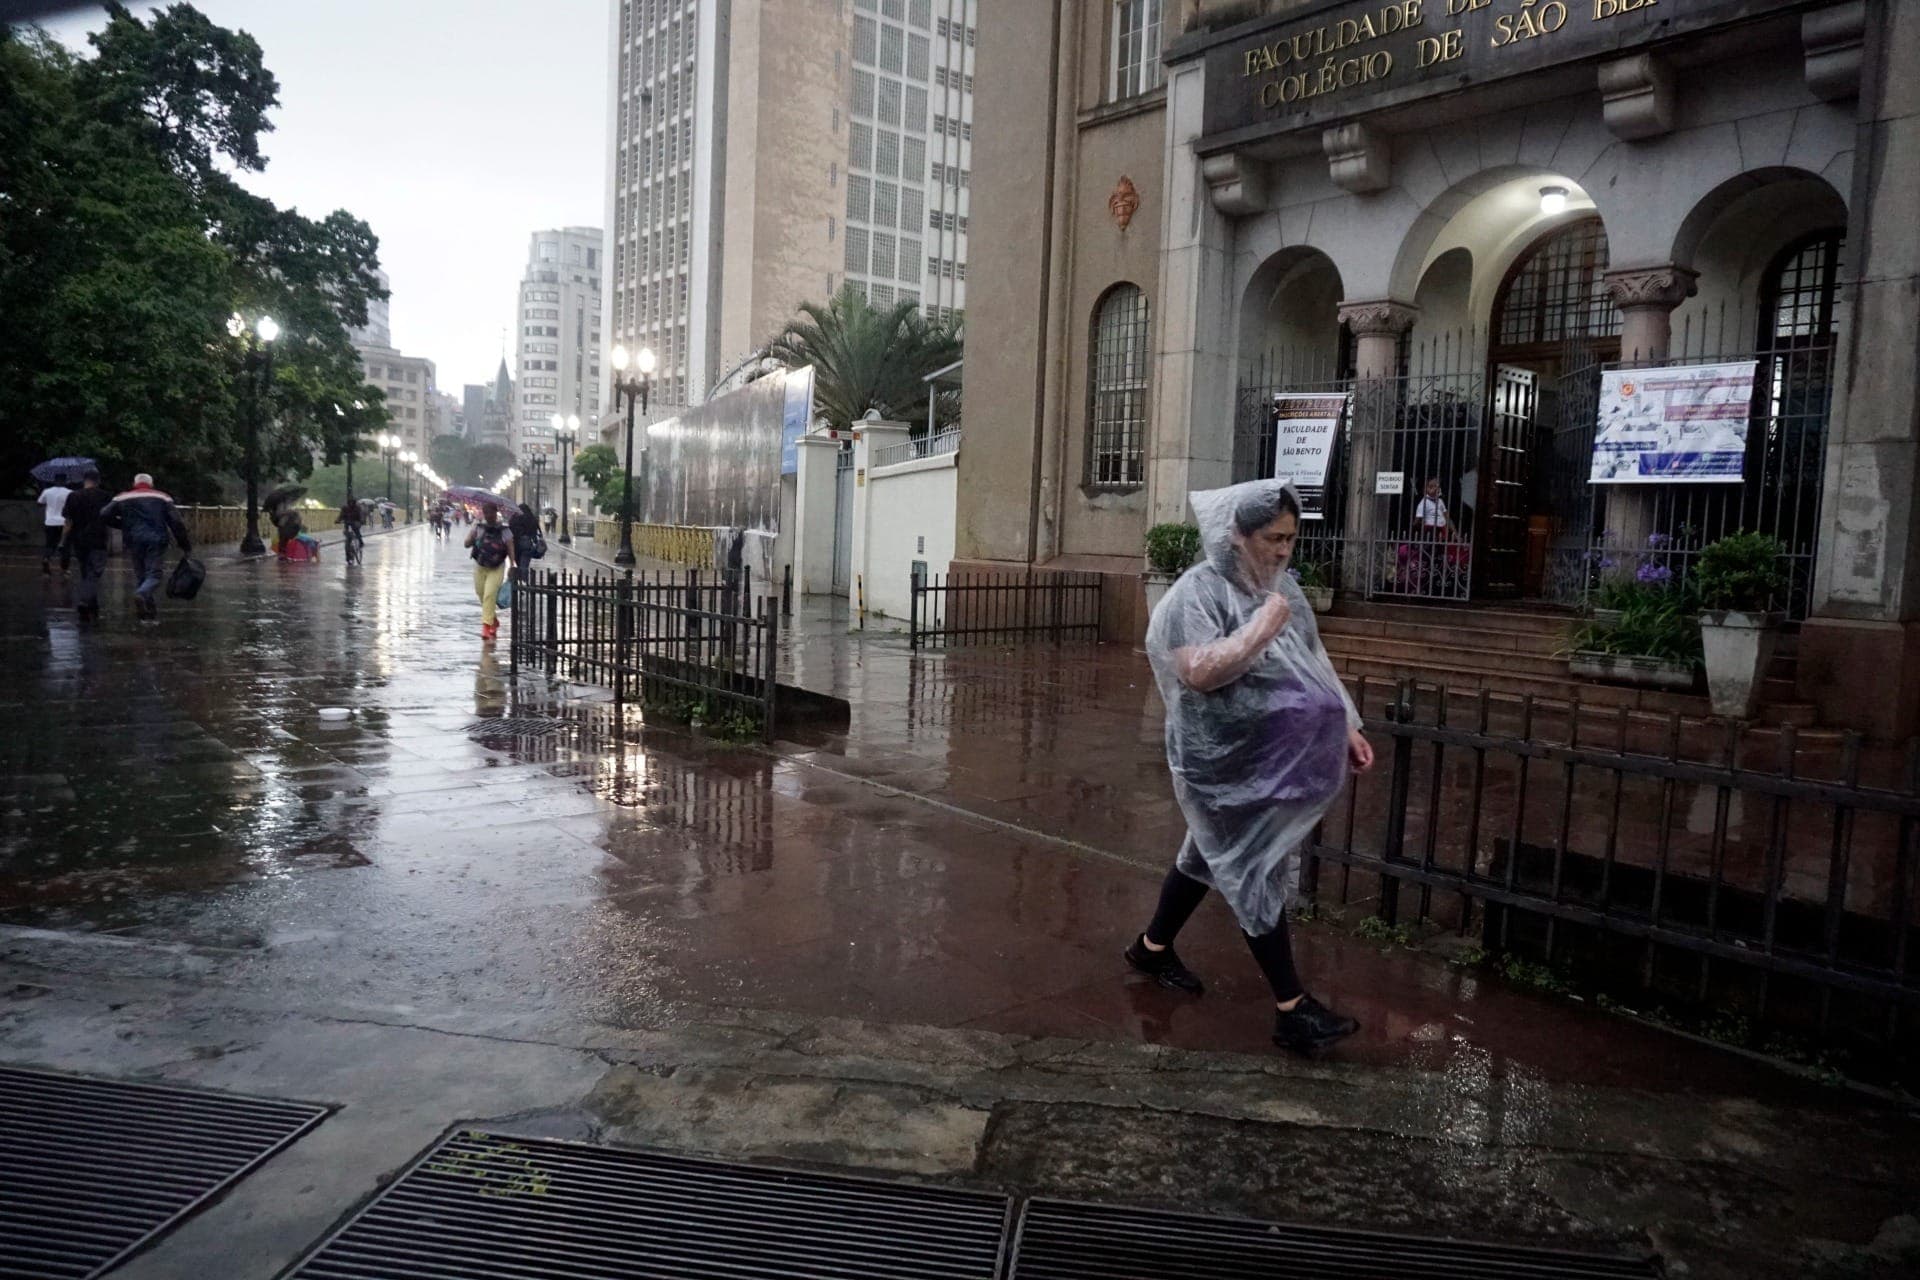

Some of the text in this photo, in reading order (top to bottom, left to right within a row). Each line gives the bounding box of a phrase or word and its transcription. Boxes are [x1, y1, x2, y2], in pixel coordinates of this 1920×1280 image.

[1243, 0, 1423, 77] FACULDADE
[1261, 50, 1393, 109] COLÉGIO
[1416, 29, 1465, 69] DE
[1491, 0, 1568, 47] SÃO
[1283, 425, 1328, 433] FACULDADE
[1296, 436, 1308, 444] DE
[1282, 446, 1322, 456] SÃO BENTO
